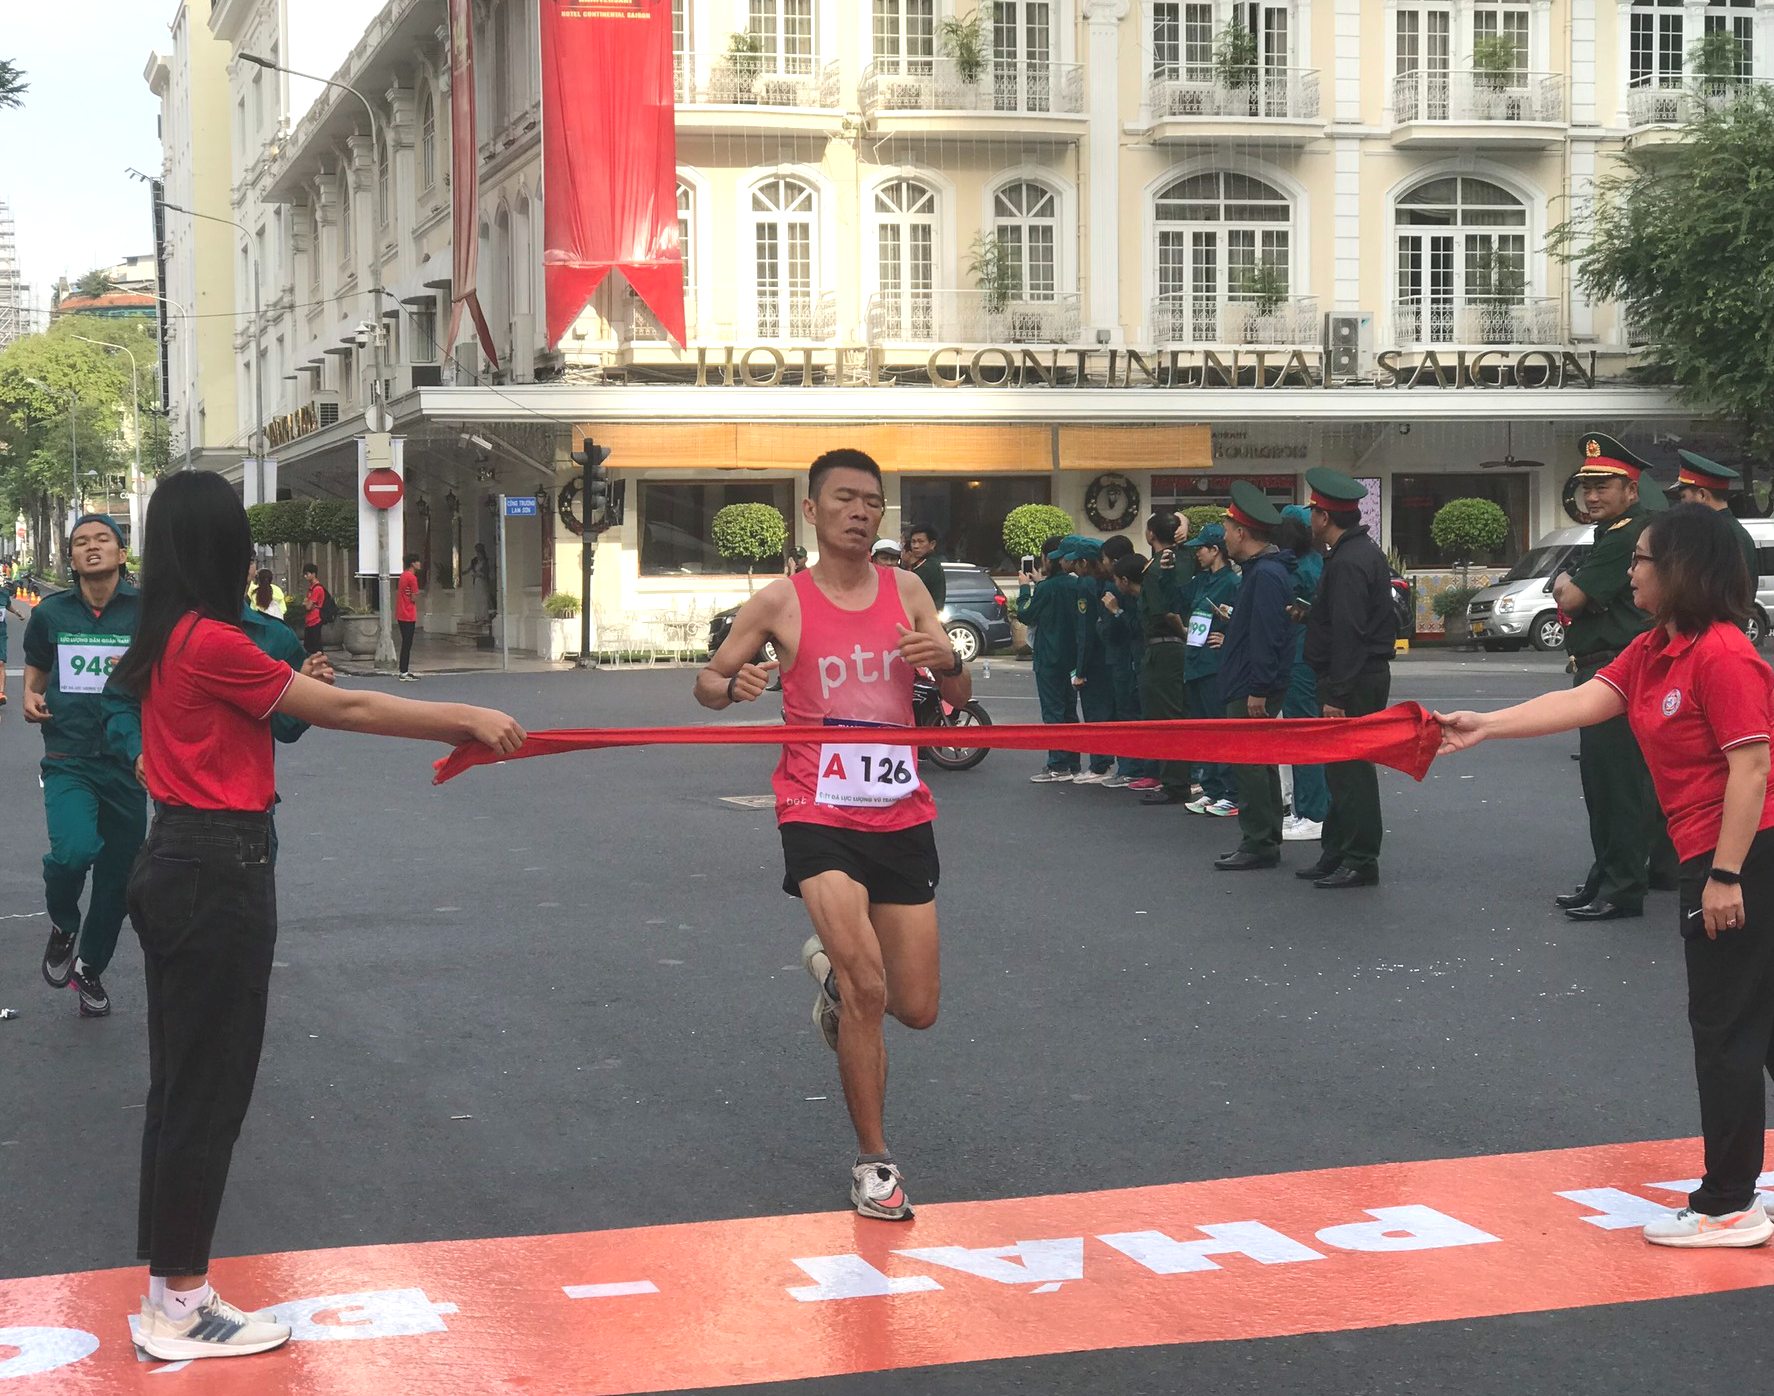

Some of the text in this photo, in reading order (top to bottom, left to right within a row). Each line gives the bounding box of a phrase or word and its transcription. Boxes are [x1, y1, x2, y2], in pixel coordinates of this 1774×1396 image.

[695, 346, 1598, 389] HOTEL CONTINENTAL SAIGON
[71, 655, 113, 676] 948
[822, 753, 912, 784] A 126
[785, 1204, 1503, 1303] PHÁT
